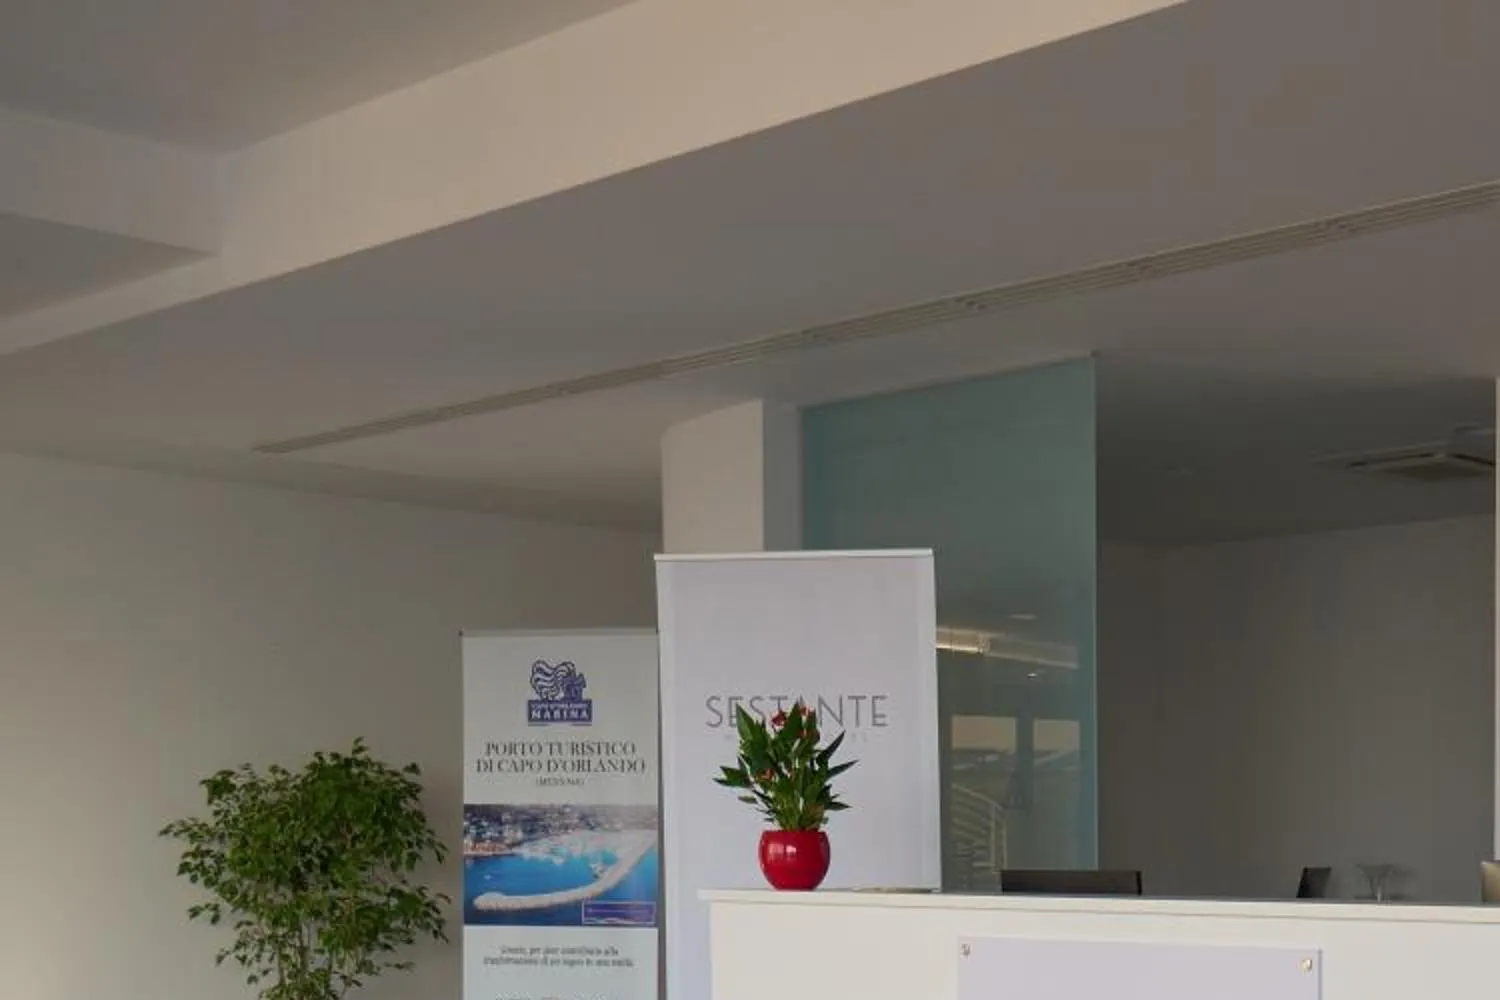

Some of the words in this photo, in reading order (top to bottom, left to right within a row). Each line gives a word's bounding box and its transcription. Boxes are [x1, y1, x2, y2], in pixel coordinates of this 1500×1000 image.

[705, 694, 889, 728] SESTNTE
[485, 740, 543, 757] PORTO
[548, 740, 637, 757] TURISTICO
[476, 757, 494, 774] DI
[497, 757, 543, 774] CAPO
[547, 757, 646, 774] D'ORLANDO
